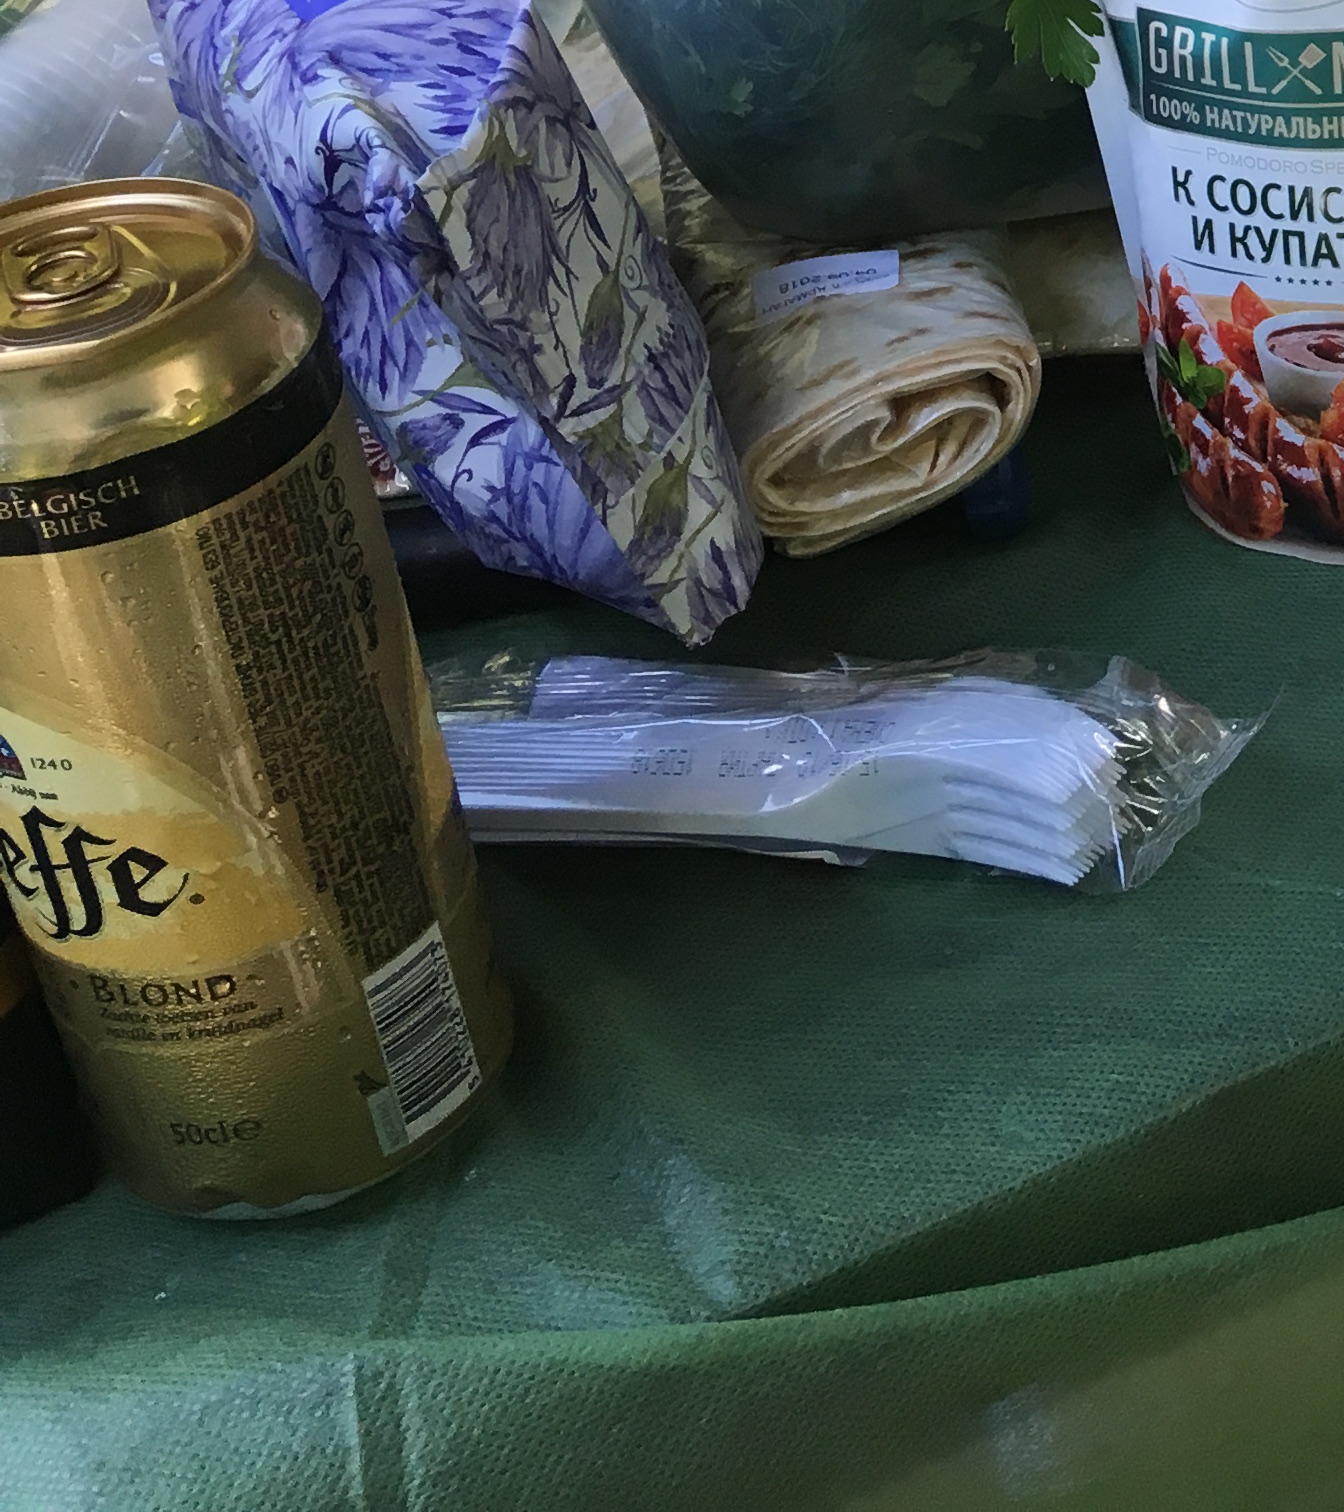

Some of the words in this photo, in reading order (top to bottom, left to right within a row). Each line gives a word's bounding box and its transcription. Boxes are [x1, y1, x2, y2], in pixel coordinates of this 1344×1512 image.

[1149, 20, 1267, 95] GRILL
[1149, 92, 1201, 125] 100%
[1171, 165, 1196, 207] К
[1191, 215, 1215, 255] И
[0, 475, 140, 521] BELGISCH
[40, 511, 108, 539] BIER
[30, 757, 73, 771] 1240
[88, 974, 237, 1007] BLOND
